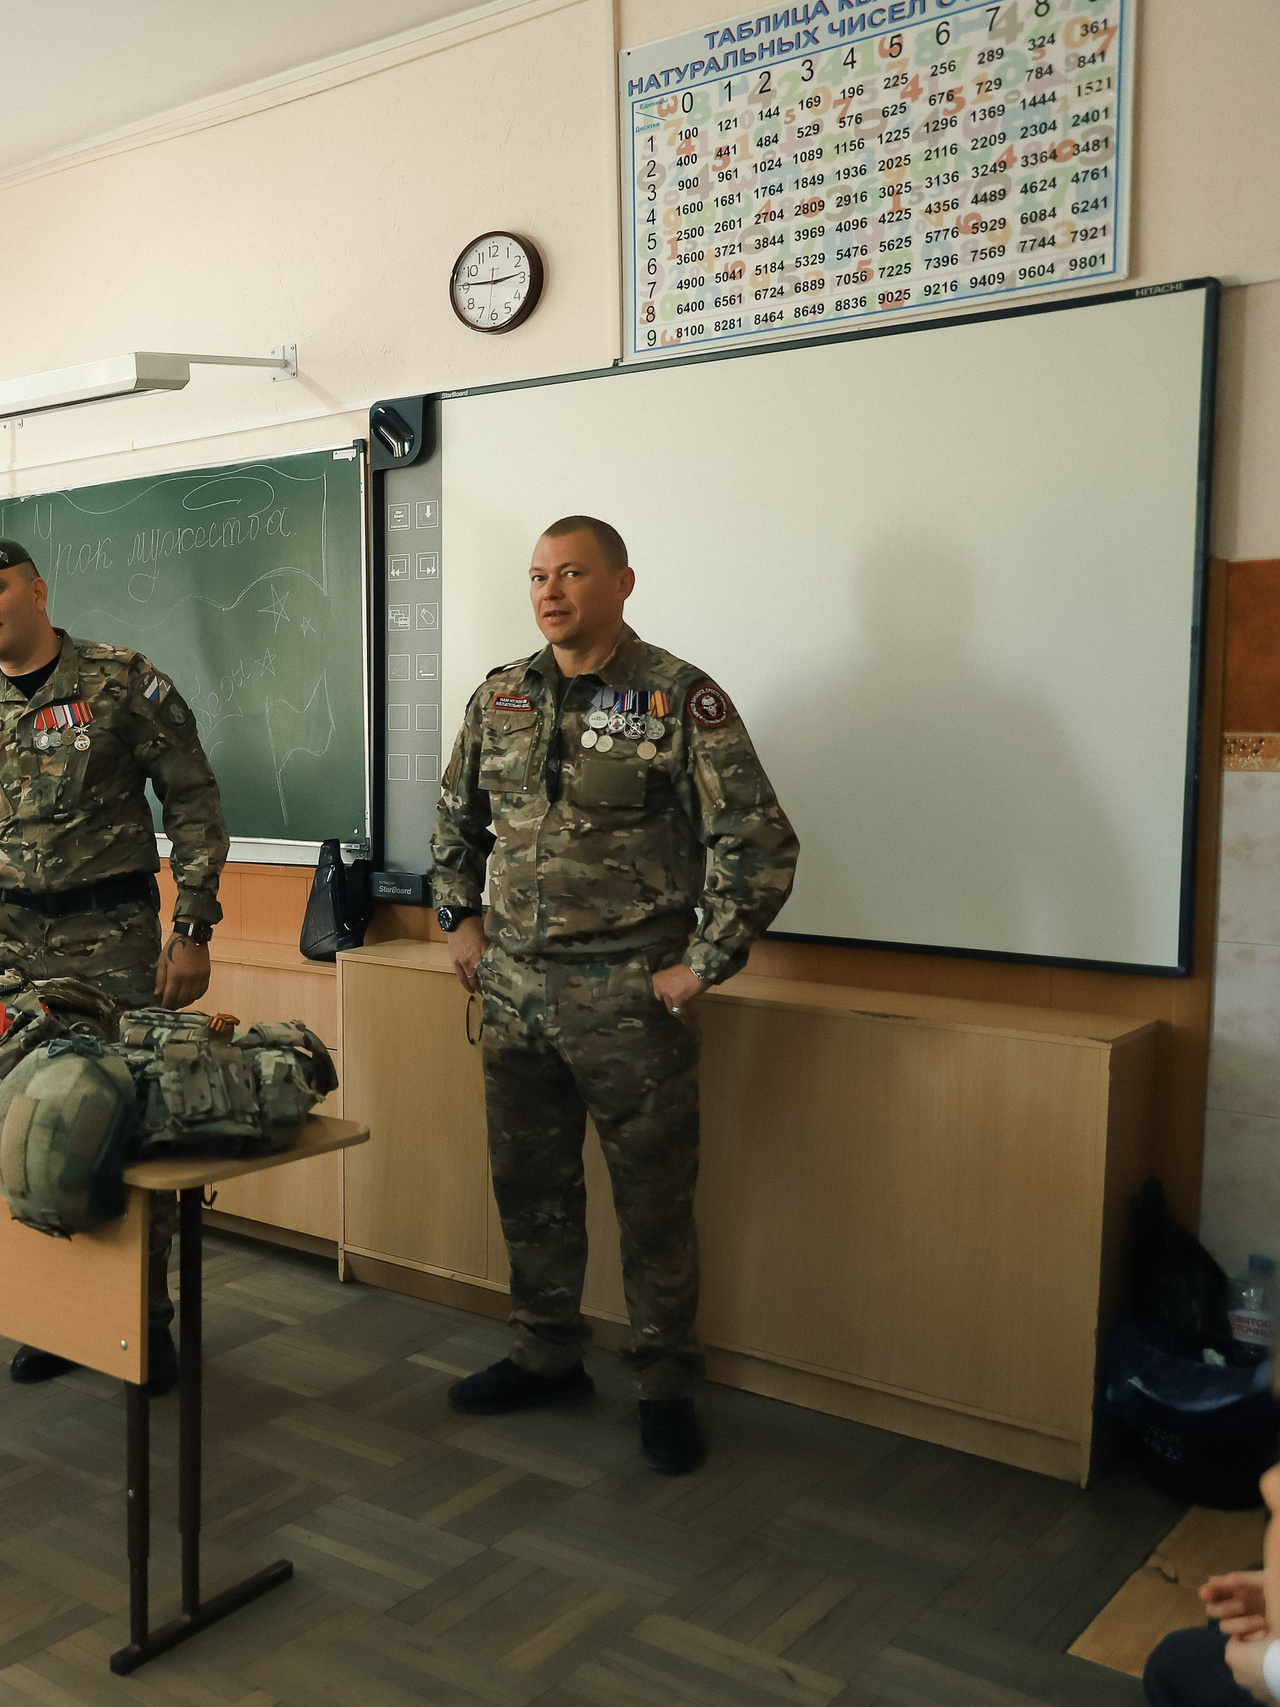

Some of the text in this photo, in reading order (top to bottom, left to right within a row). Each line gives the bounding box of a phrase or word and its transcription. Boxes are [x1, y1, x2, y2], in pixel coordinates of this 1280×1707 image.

[704, 2, 830, 50] ТАБЛИЦА
[627, 0, 926, 97] НАТУРАЛЬНЫХ ЧИСЕЛ
[682, 92, 693, 113] 0
[724, 81, 731, 102] 1
[759, 71, 771, 94] 2
[802, 60, 814, 82] 3
[843, 47, 856, 69] 4
[889, 34, 902, 58] 5
[936, 22, 950, 45] 6
[986, 6, 1000, 31] 7
[648, 19, 1107, 152] 1 100 121 144 169 196 225 256 289 324 361
[647, 50, 1105, 177] 2 400 441 484 529 576 625 676 729 784 841
[635, 122, 660, 134] Десятки
[648, 77, 1112, 201] 3 900 961 1024 1089 1156 1225 1296 1369 1444 1521
[647, 107, 1108, 225] 4 1600 1681 1764 1849 1936 2025 2116 2209 2304 2401
[648, 137, 1108, 250] 5 2500 2601 2704 2809 2916 3025 3136 3249 3364 3481
[648, 166, 1107, 275] 6 3600 3721 3844 3969 4096 4225 4356 4489 4624 4761
[488, 244, 499, 258] 12
[506, 246, 510, 258] 1
[648, 196, 1107, 298] 7 4900 5041 5184 5329 5476 5625 5776 5929 6084 6241
[478, 252, 484, 264] 11
[514, 255, 521, 268] 2
[467, 264, 478, 277] 10
[518, 271, 526, 284] 3
[646, 225, 1106, 322] 8 6400 6561 6724 6889 7056 7225 7396 7569 7744 7921
[462, 282, 470, 294] 9
[1135, 282, 1182, 297] HITACHI
[513, 290, 521, 301] 4
[648, 254, 1104, 346] 9 8100 8281 8464 8649 8836 9025 9216 9409 9604 9801
[467, 298, 475, 310] 8
[504, 302, 512, 314] 5
[478, 306, 485, 319] 7
[490, 309, 498, 320] 6
[441, 390, 468, 399] StarBoard
[33, 502, 113, 622] Урок
[379, 885, 412, 895] StarBoard
